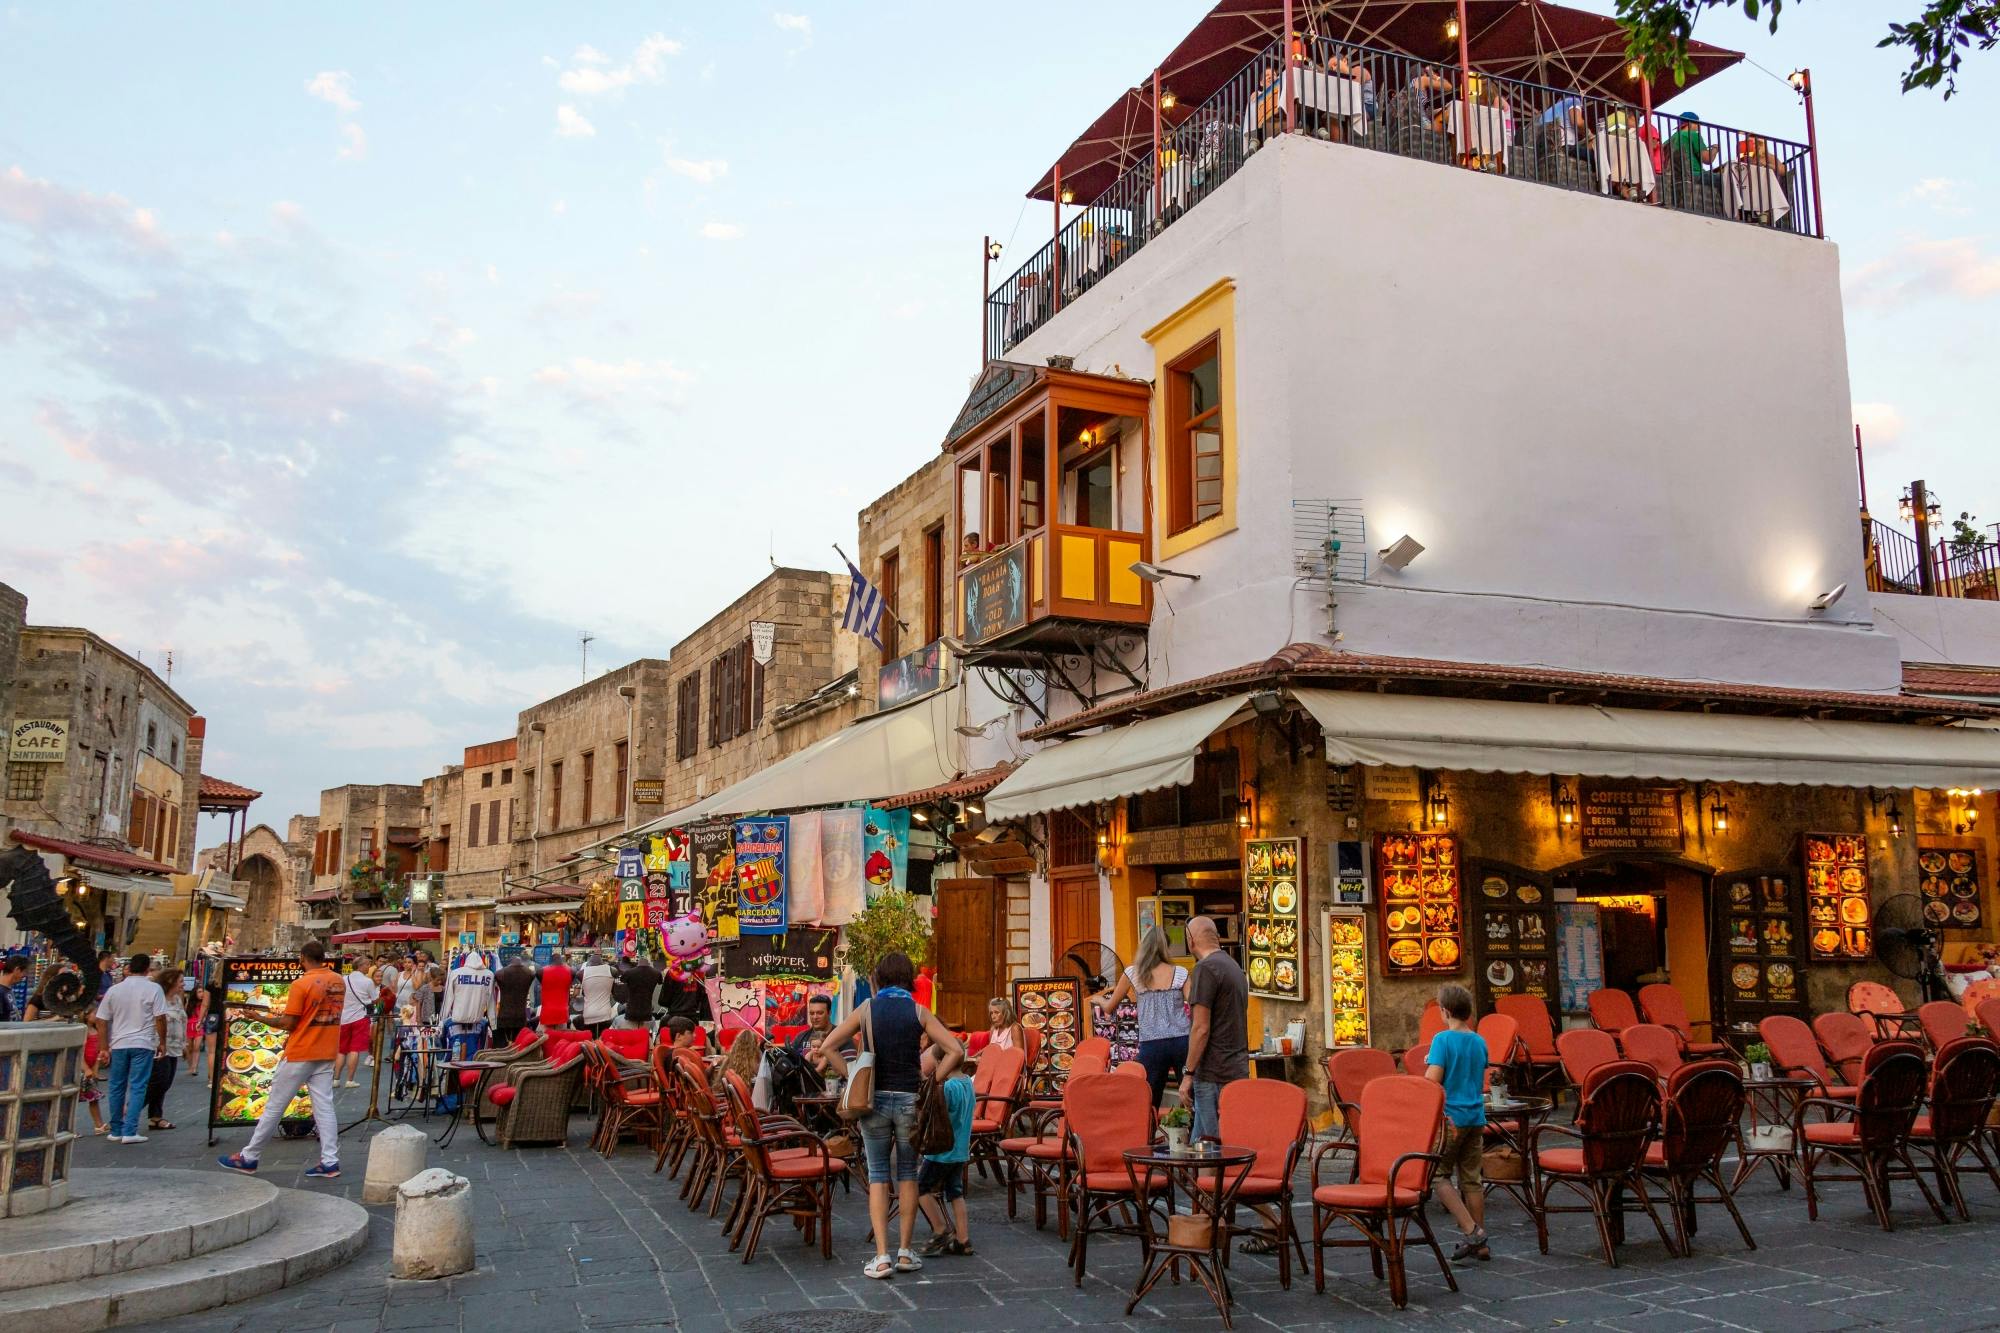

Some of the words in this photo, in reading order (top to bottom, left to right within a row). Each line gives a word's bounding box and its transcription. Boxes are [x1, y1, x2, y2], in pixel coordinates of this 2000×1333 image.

[15, 720, 65, 738] RESTAURANT
[17, 736, 61, 748] CAFE
[13, 751, 63, 760] SINTRIVANI
[1591, 791, 1633, 803] COFFEE
[1637, 792, 1659, 804] BAR
[1587, 806, 1623, 815] COCTAILS
[1629, 807, 1647, 815] SOFT
[1649, 807, 1675, 816] DRINKS
[1592, 817, 1616, 825] BEERS
[694, 831, 727, 844] RHODES
[1584, 827, 1595, 836] ICE
[1630, 827, 1648, 836] MILK
[1650, 828, 1679, 837] SHAKES
[1184, 837, 1215, 849] NICOLAS
[1588, 839, 1637, 848] SANDWICHES
[1643, 839, 1673, 848] SNACKS
[1149, 851, 1180, 863] COCKTAIL
[1184, 848, 1209, 861] SNACK
[1212, 846, 1228, 859] BAR
[648, 854, 666, 870] 24
[624, 863, 637, 877] 13
[625, 885, 639, 900] 34
[649, 884, 667, 898] 23
[1340, 883, 1362, 891] WI-FI
[649, 911, 665, 925] 23
[736, 908, 781, 916] BARCELONA
[625, 912, 640, 929] 23
[752, 953, 808, 967] MONSTER
[230, 962, 286, 971] CAPTAINS
[458, 974, 491, 986] HELLAS
[1019, 983, 1043, 992] GYROS
[1044, 982, 1074, 991] SPECIAL
